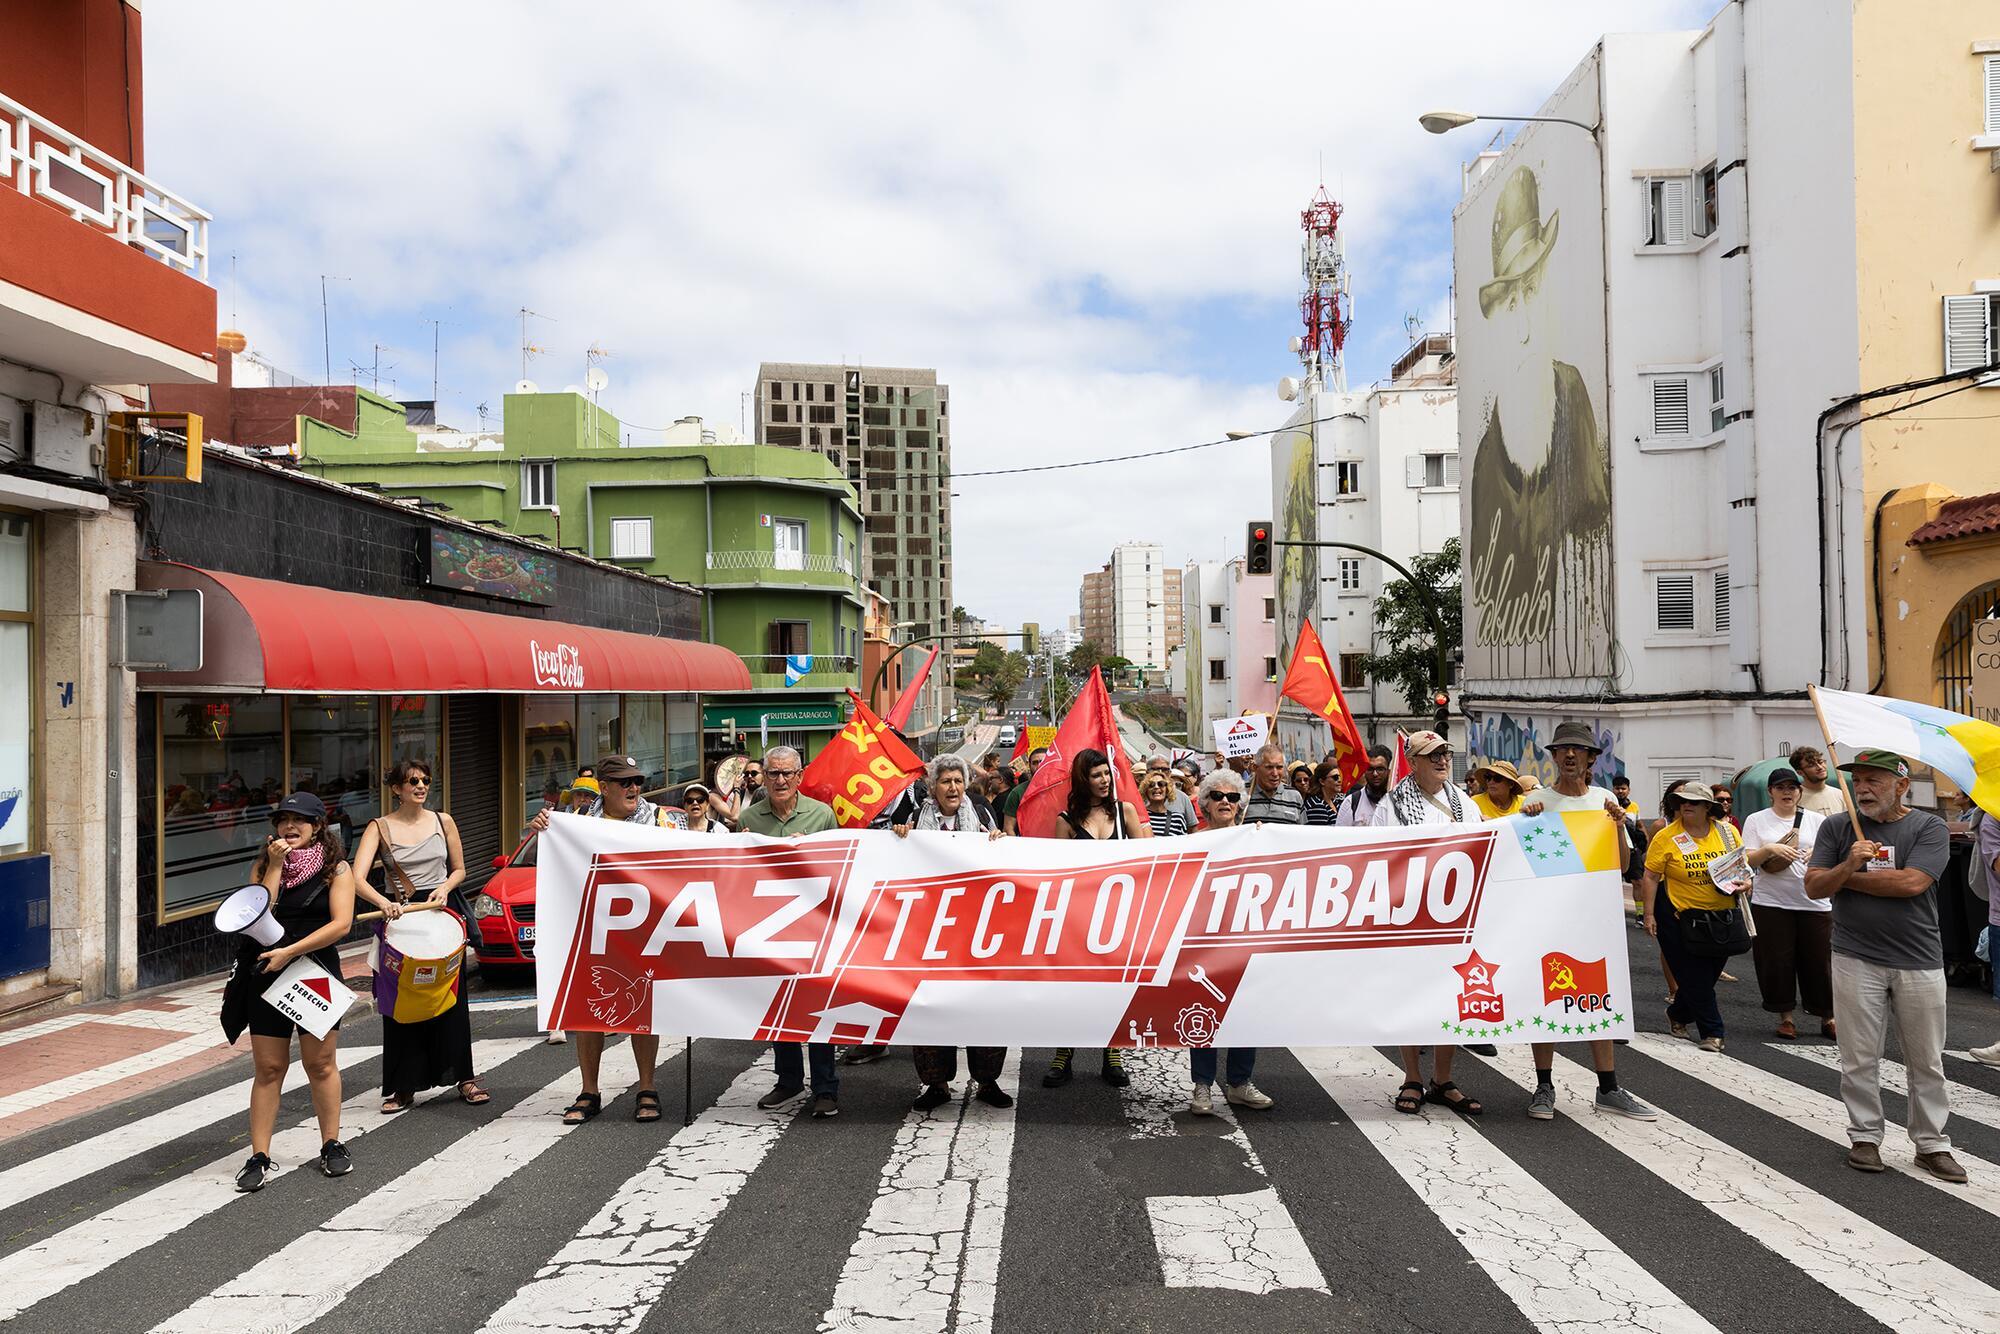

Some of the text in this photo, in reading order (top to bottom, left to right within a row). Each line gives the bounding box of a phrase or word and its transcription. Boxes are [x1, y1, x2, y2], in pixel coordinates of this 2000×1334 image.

[1476, 544, 1552, 647] abuelo
[798, 711, 832, 719] ZARAGOZA
[1228, 732, 1258, 741] DERECHO
[1230, 748, 1251, 756] TECHO
[1682, 853, 1702, 862] QUE
[1704, 851, 1718, 860] NO
[1685, 861, 1709, 870] ROB
[590, 850, 1475, 961] PAZ TECHO TRABAJO
[284, 992, 295, 1003] AL
[291, 983, 329, 1012] DERECHO
[1462, 993, 1612, 1014] JCPC PCPC
[276, 1000, 303, 1021] TECHO
